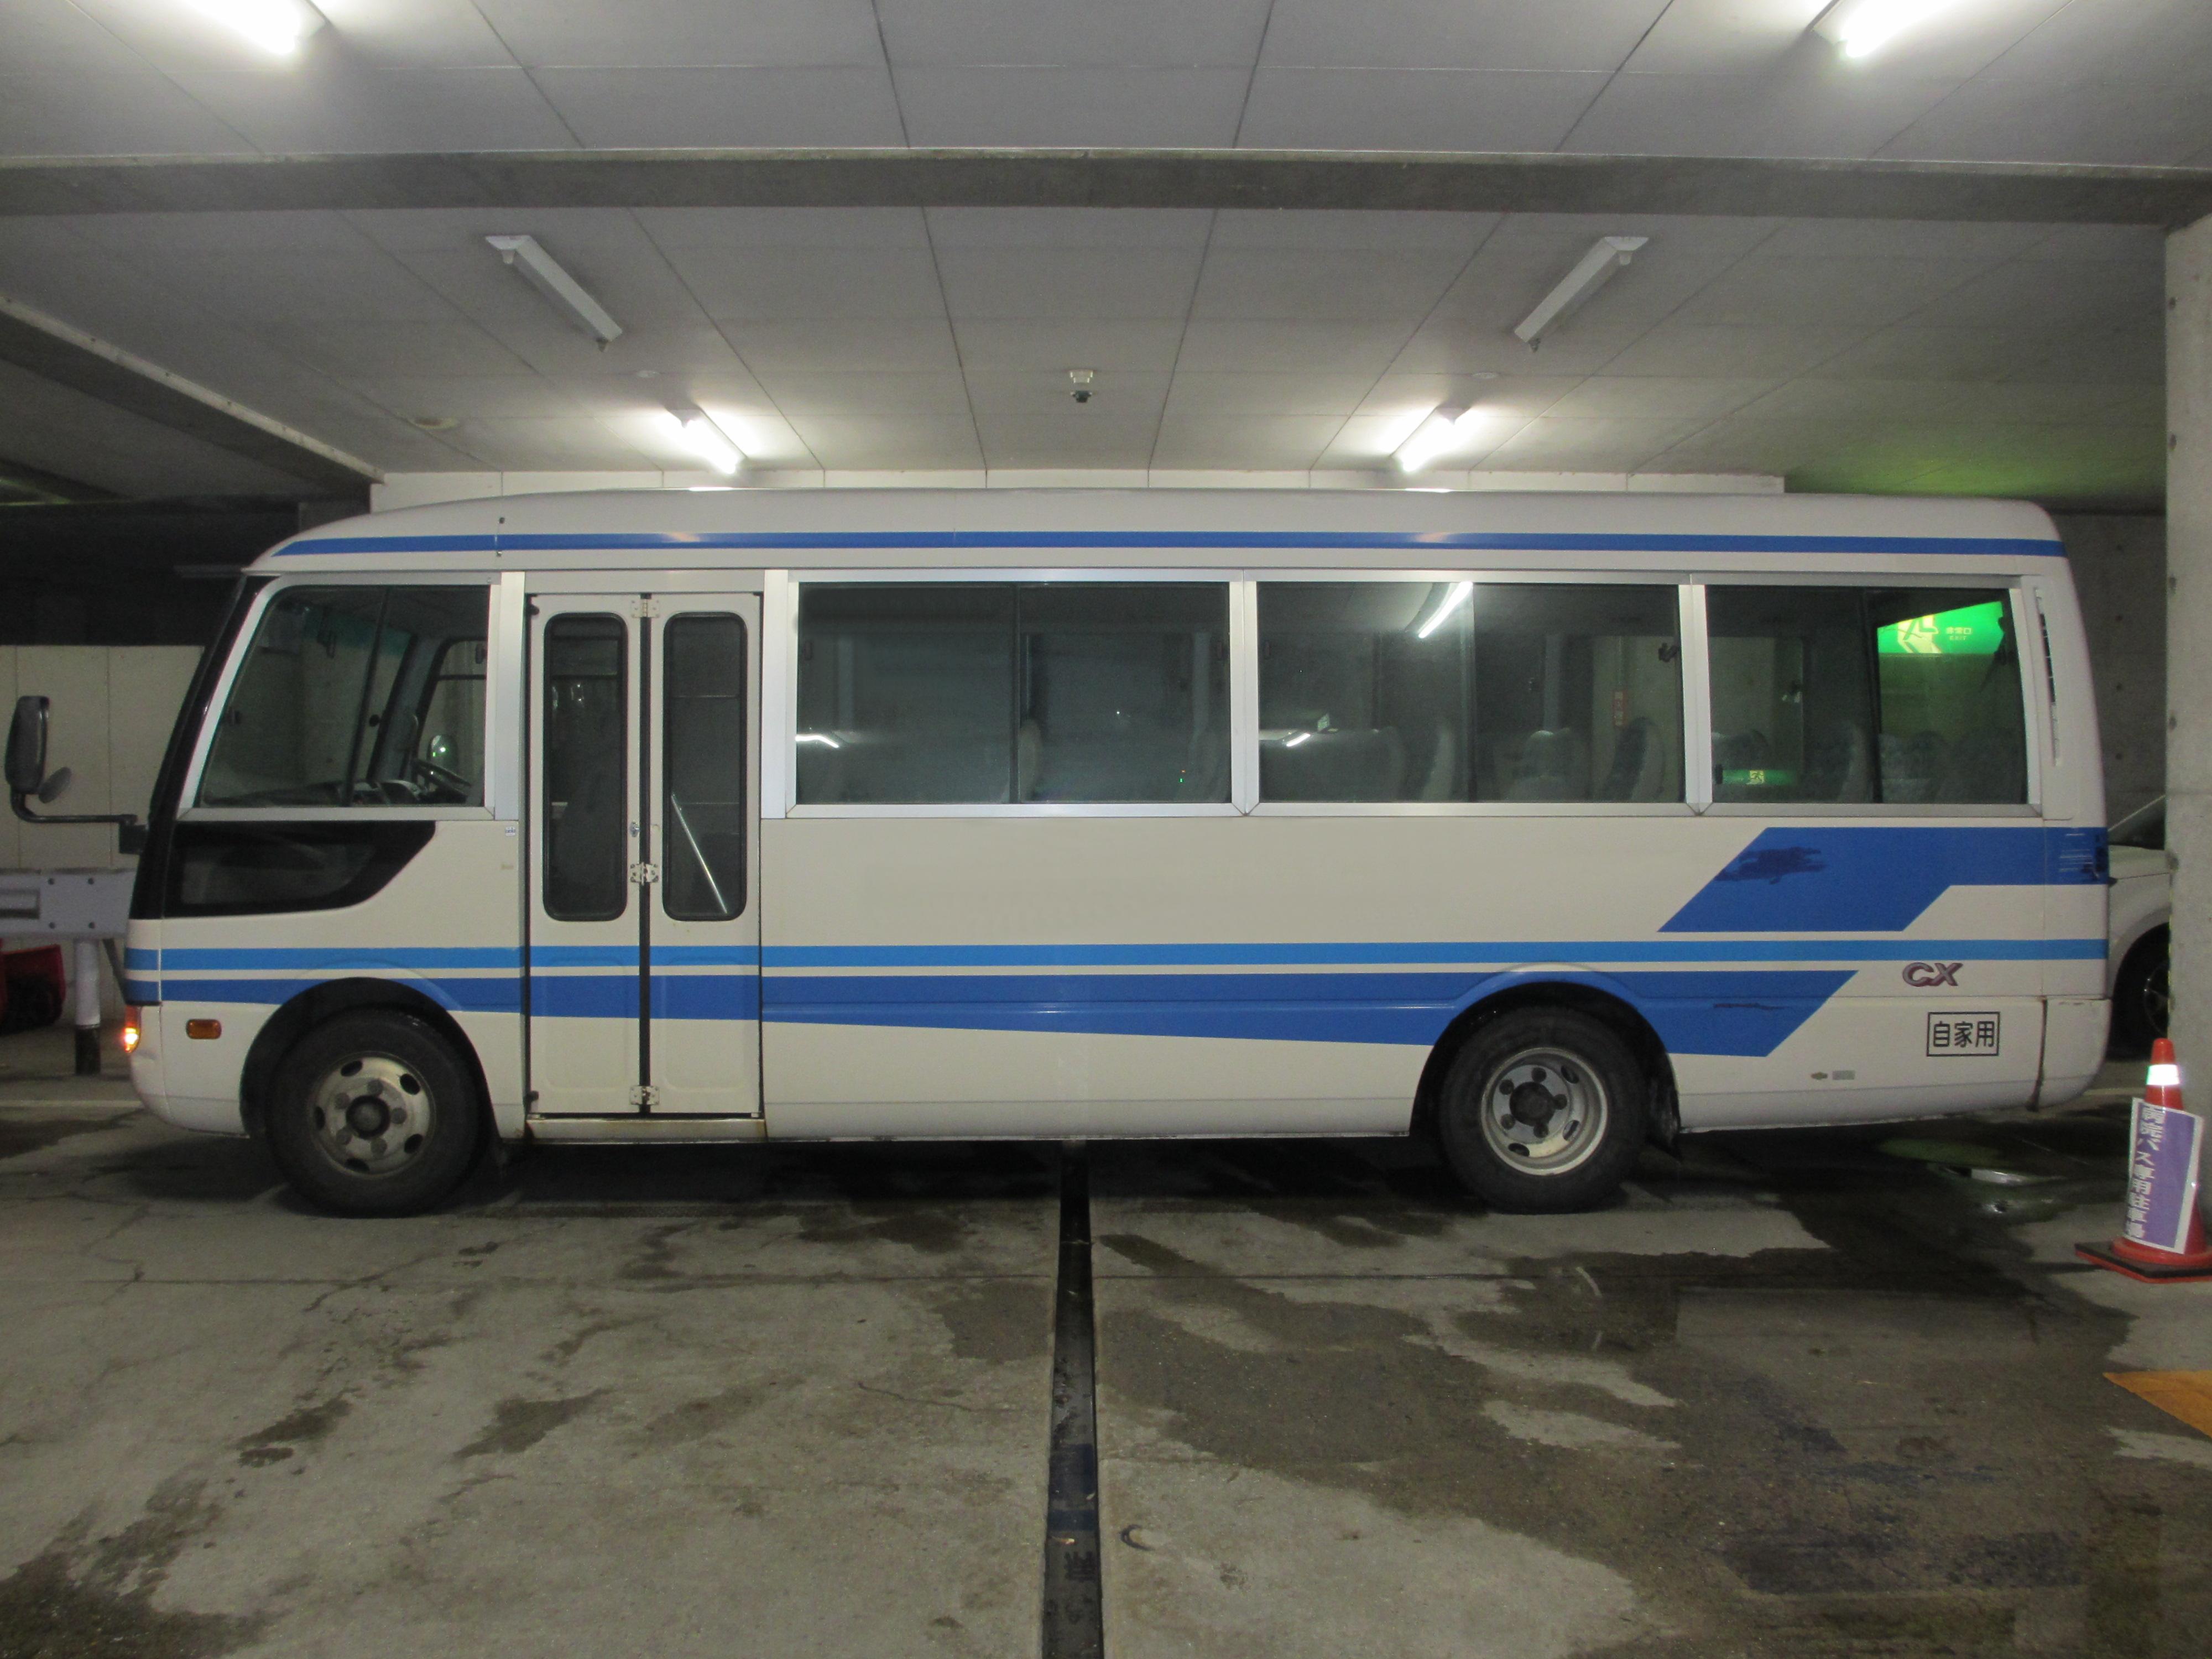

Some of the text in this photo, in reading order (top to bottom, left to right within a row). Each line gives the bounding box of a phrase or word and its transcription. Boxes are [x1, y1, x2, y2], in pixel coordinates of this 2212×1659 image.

[1902, 962, 1963, 987] CX
[1932, 1021, 1995, 1048] 自家用
